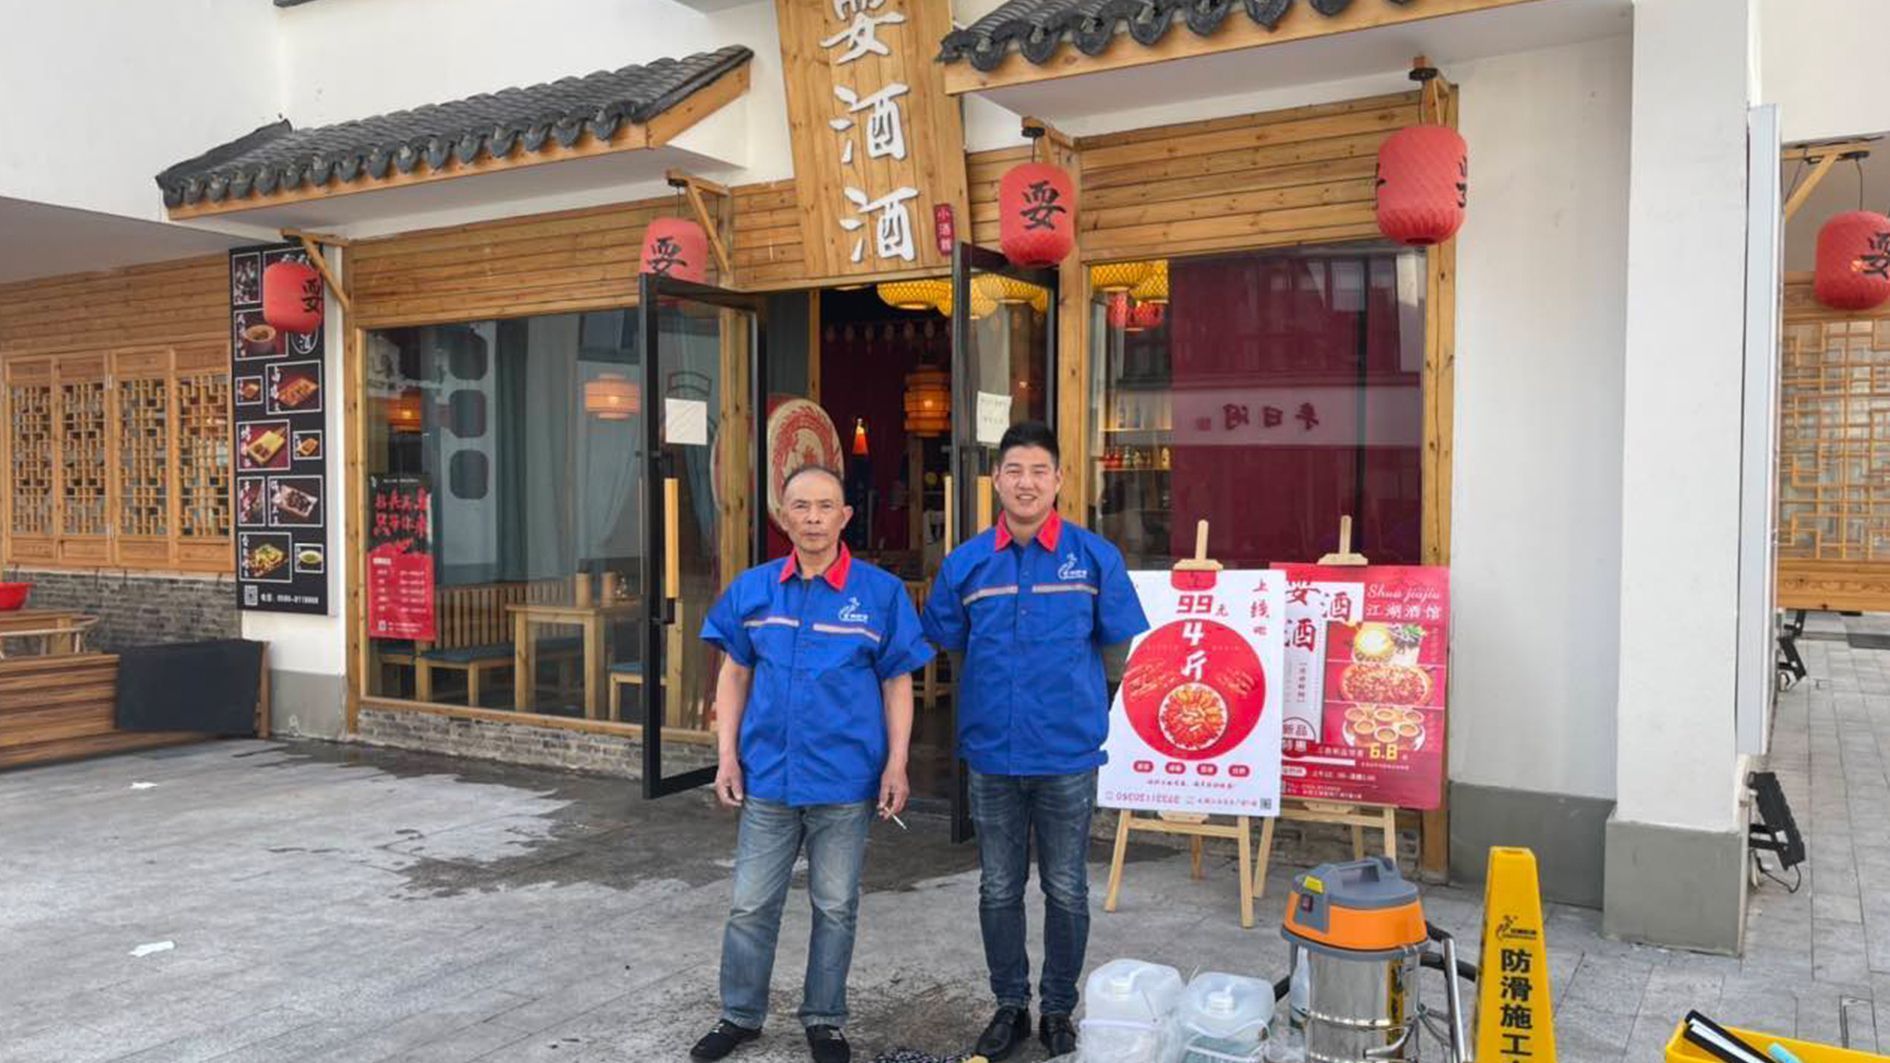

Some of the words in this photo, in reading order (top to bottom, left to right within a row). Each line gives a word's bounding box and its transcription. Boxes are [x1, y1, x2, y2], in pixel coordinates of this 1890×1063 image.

[1020, 180, 1066, 230] 耍
[1366, 603, 1442, 620] 江湖酒馆
[1500, 949, 1533, 1063] 防滑施工
